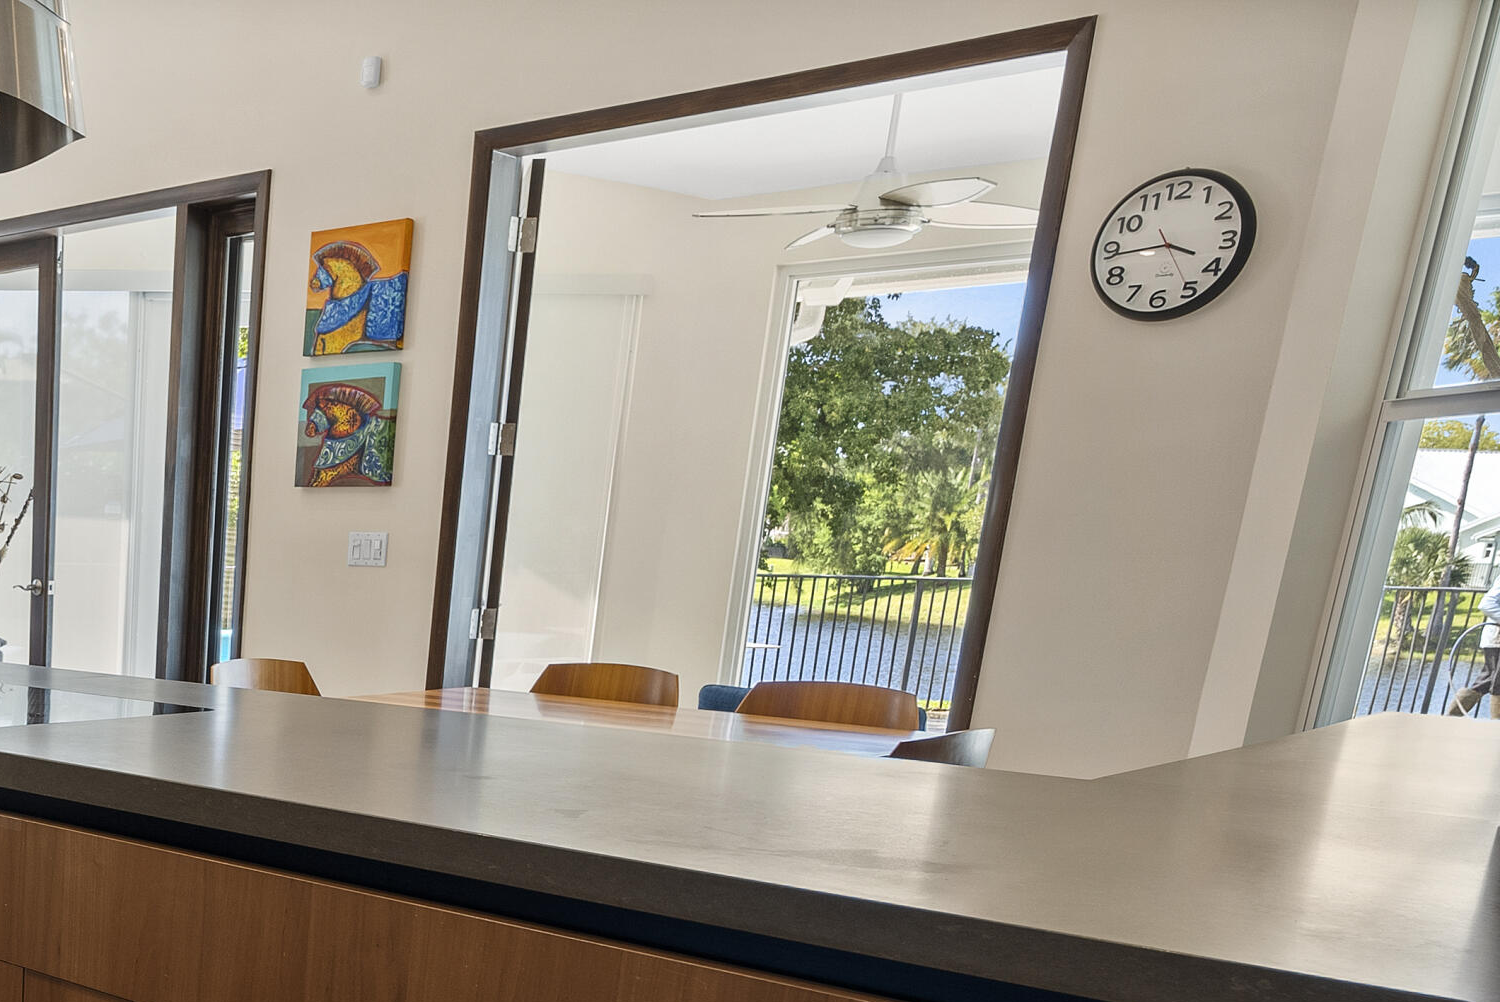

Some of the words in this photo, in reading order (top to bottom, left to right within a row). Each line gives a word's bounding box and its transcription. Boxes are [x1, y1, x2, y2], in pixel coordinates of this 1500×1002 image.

[1165, 180, 1192, 201] 12
[1202, 185, 1213, 204] 1
[1139, 192, 1161, 212] 11
[1214, 200, 1234, 221] 2
[1117, 214, 1143, 233] 10
[1103, 240, 1121, 260] 9
[1218, 230, 1238, 250] 3
[1106, 266, 1125, 286] 8
[1201, 257, 1222, 276] 4
[1126, 284, 1142, 303] 7
[1148, 289, 1167, 309] 6
[1180, 280, 1198, 299] 5
